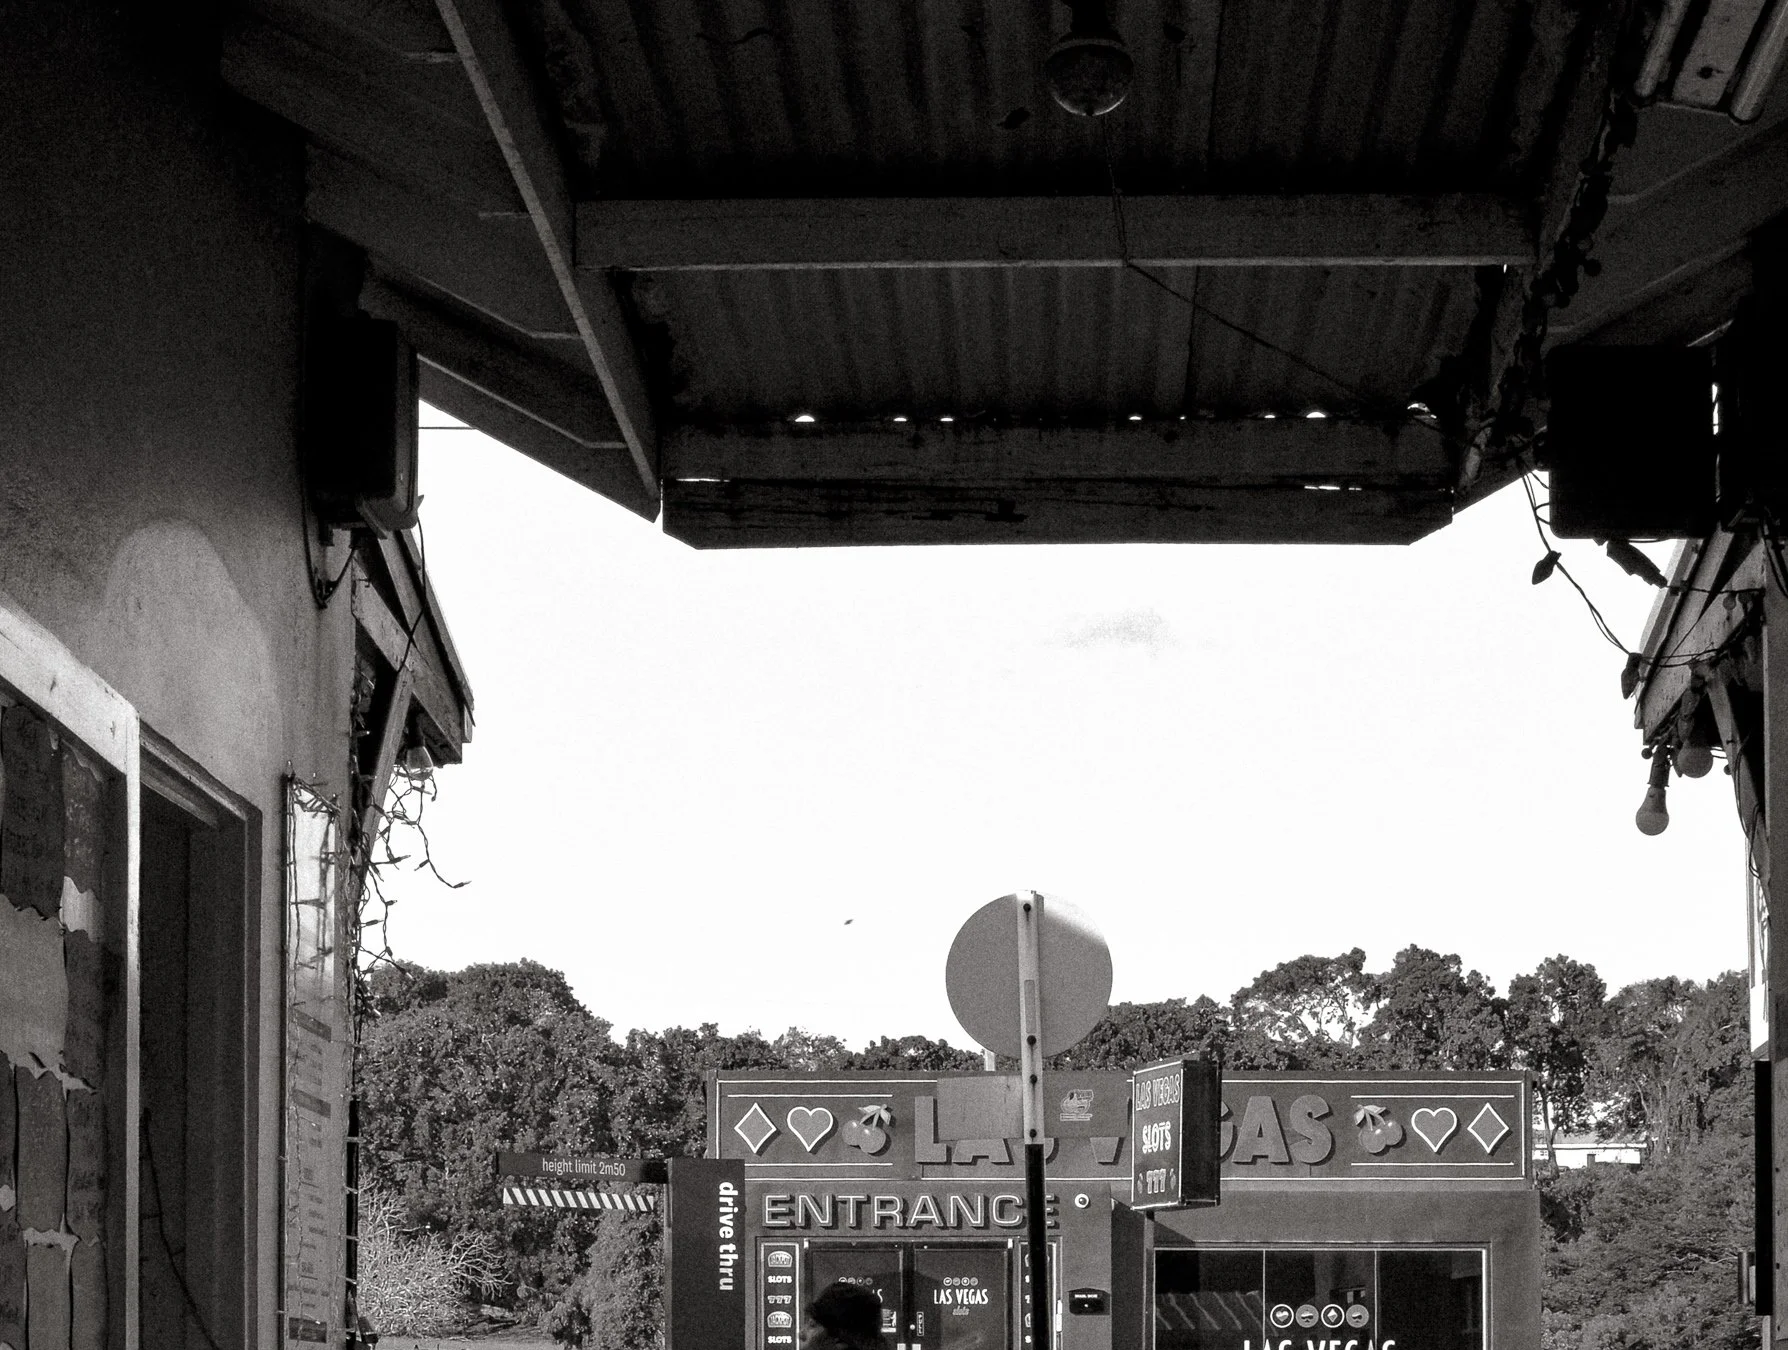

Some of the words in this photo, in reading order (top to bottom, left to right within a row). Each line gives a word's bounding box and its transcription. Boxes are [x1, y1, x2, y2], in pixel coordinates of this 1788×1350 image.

[1135, 1080, 1152, 1111] LAS
[1152, 1073, 1180, 1107] VEGAS
[1142, 1120, 1172, 1154] SLOTS
[542, 1157, 573, 1175] height
[575, 1159, 597, 1174] limit
[598, 1162, 626, 1177] 2m50
[1146, 1168, 1167, 1194] 777
[718, 1181, 738, 1239] drive
[719, 1243, 738, 1291] thru
[768, 1275, 793, 1284] SLOTS
[768, 1295, 792, 1305] 777
[933, 1288, 953, 1305] LAS
[955, 1288, 989, 1305] VEGAS
[768, 1335, 793, 1344] SLOTS
